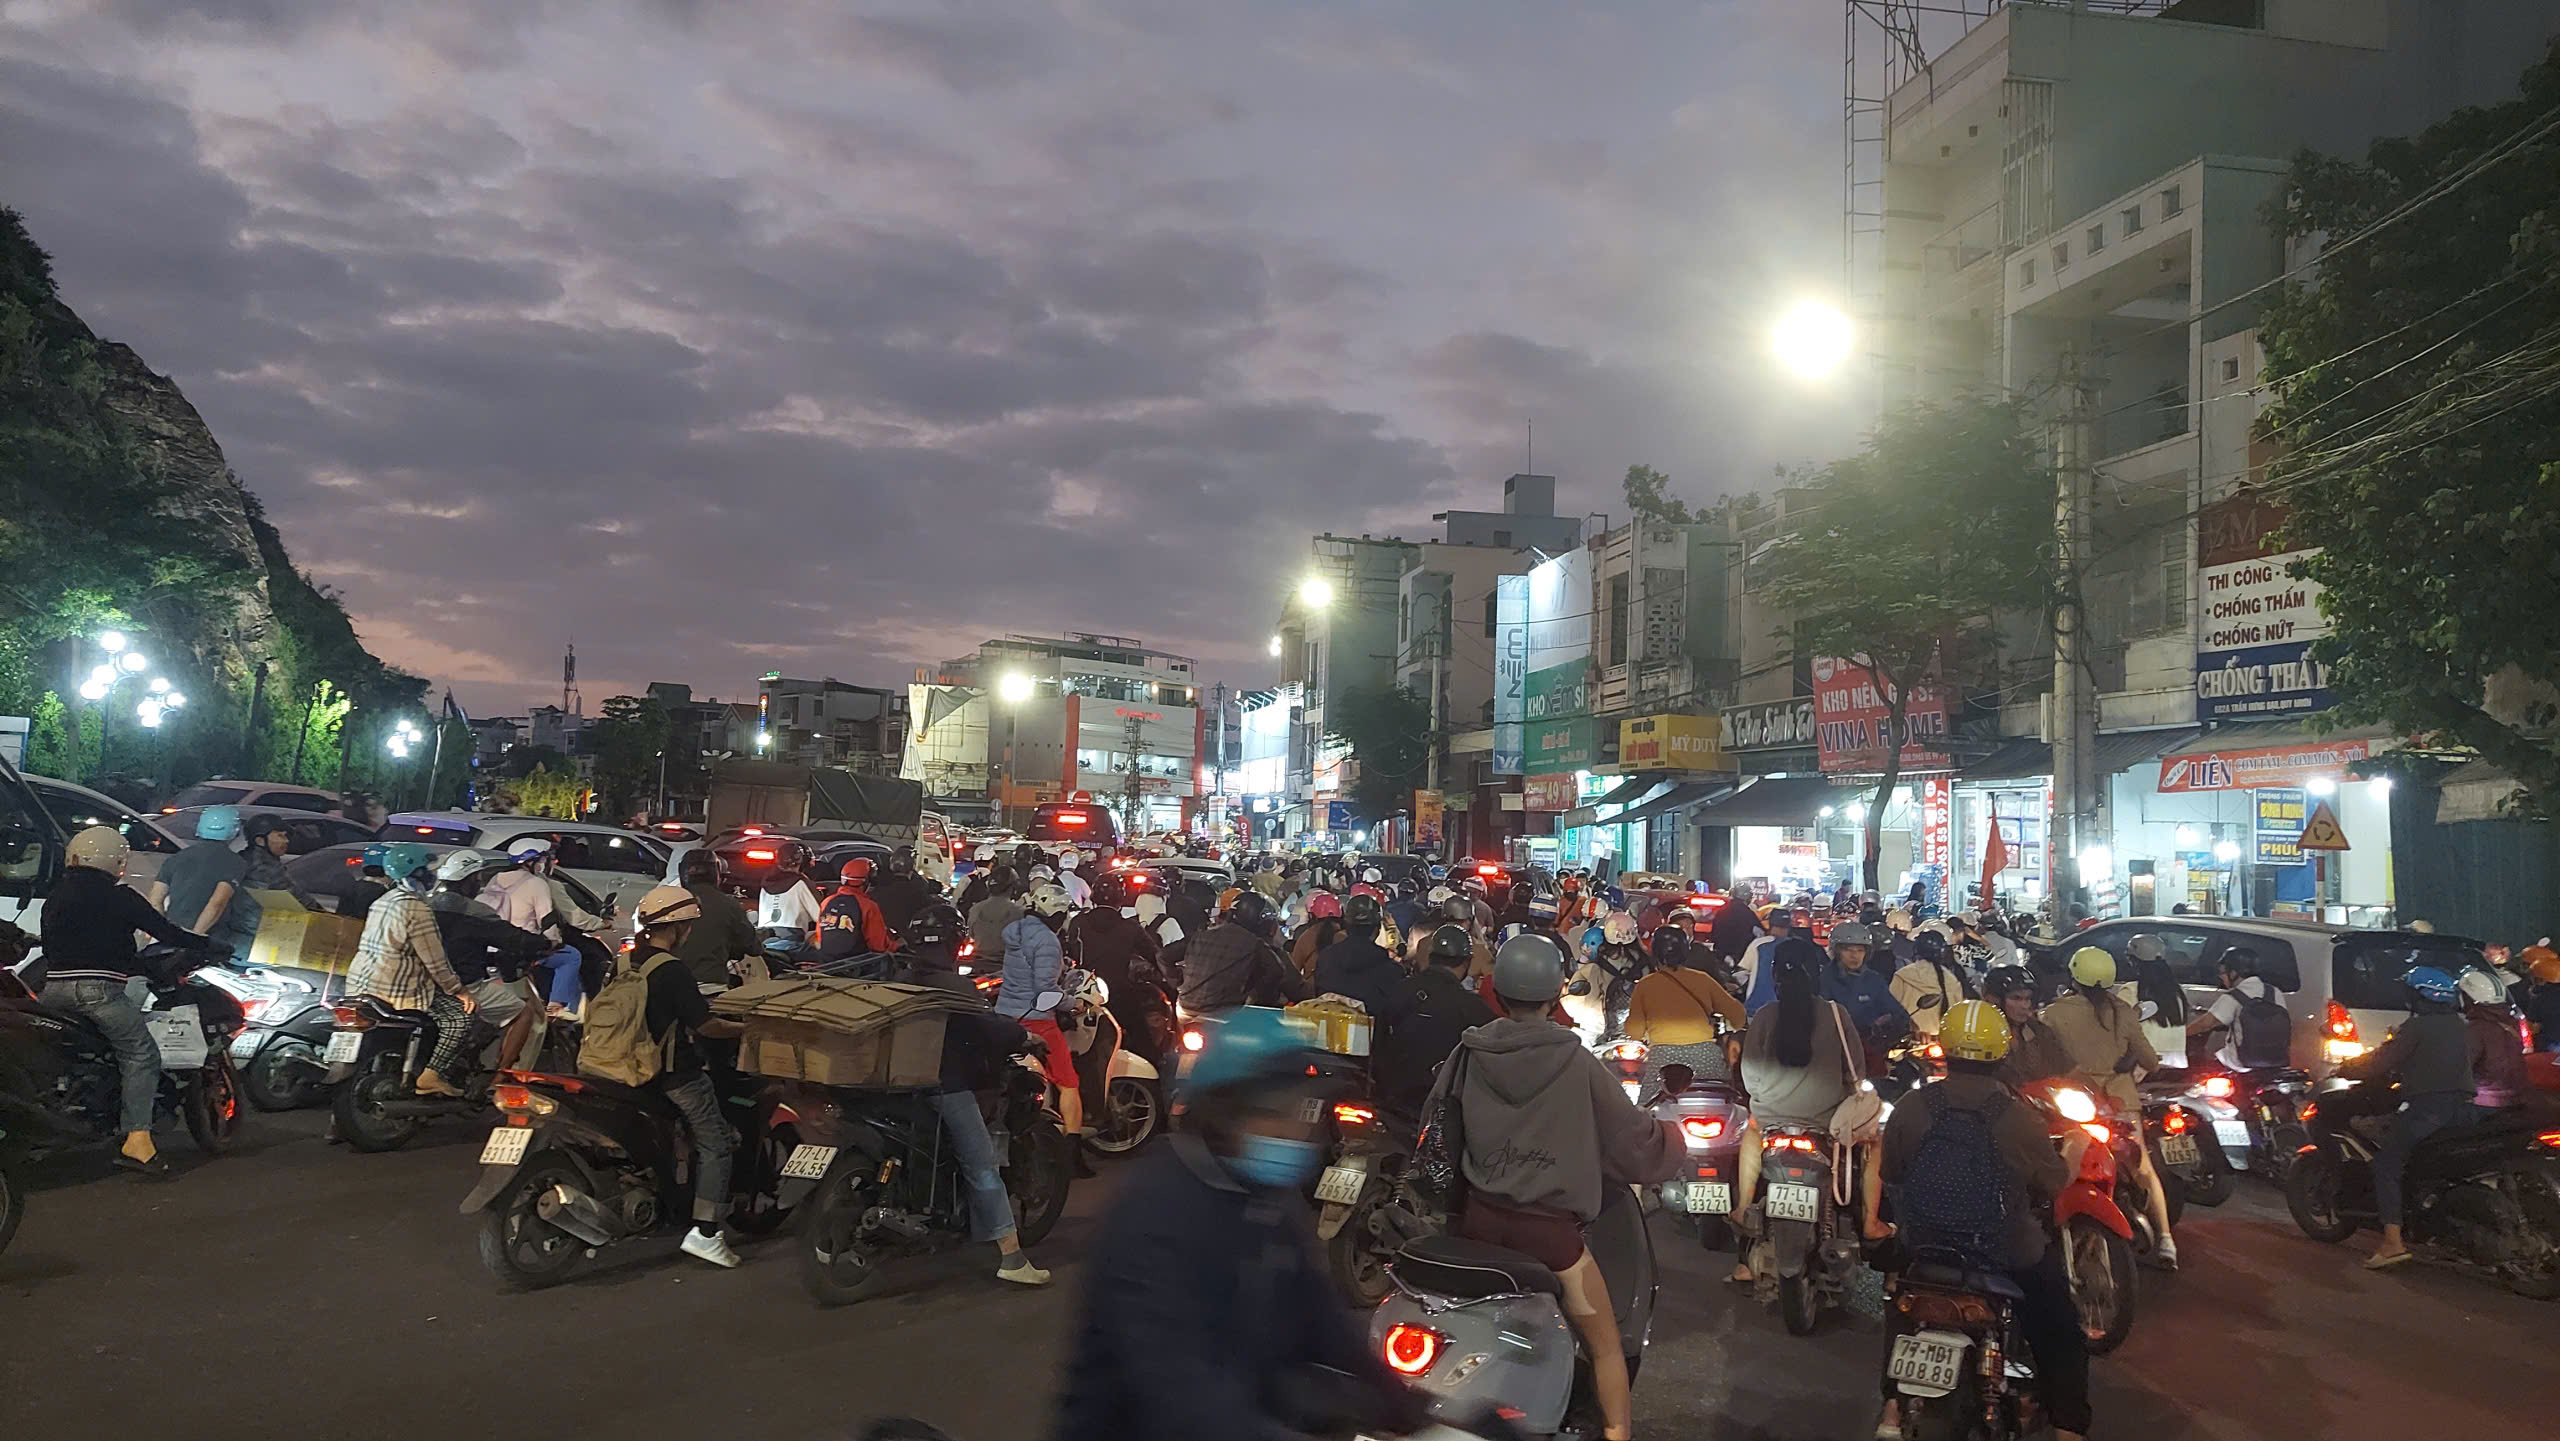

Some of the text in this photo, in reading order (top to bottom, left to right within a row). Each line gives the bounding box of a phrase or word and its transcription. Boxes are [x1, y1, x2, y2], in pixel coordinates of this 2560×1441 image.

[2208, 574, 2228, 591] THI
[2233, 566, 2273, 587] CÔNG
[2213, 585, 2305, 619] CHỐNG THẤM
[2213, 619, 2295, 647] CHỐNG NỨT
[2197, 655, 2266, 699] CHỐNG
[1527, 694, 1545, 718] KHO
[1822, 689, 1849, 713] KHO
[1693, 736, 1720, 753] DUY
[1820, 719, 1873, 753] VINA
[2189, 754, 2233, 788] LIÊN
[797, 1146, 831, 1161] 77-L1
[784, 1160, 826, 1176] 924.55
[1327, 1170, 1360, 1188] 77-L2
[1693, 1185, 1724, 1199] 77-L2
[1775, 1186, 1809, 1203] 77-L1
[1690, 1199, 1728, 1212] 332.21
[1769, 1201, 1814, 1219] 734.91
[1893, 1358, 1955, 1386] 008.89
